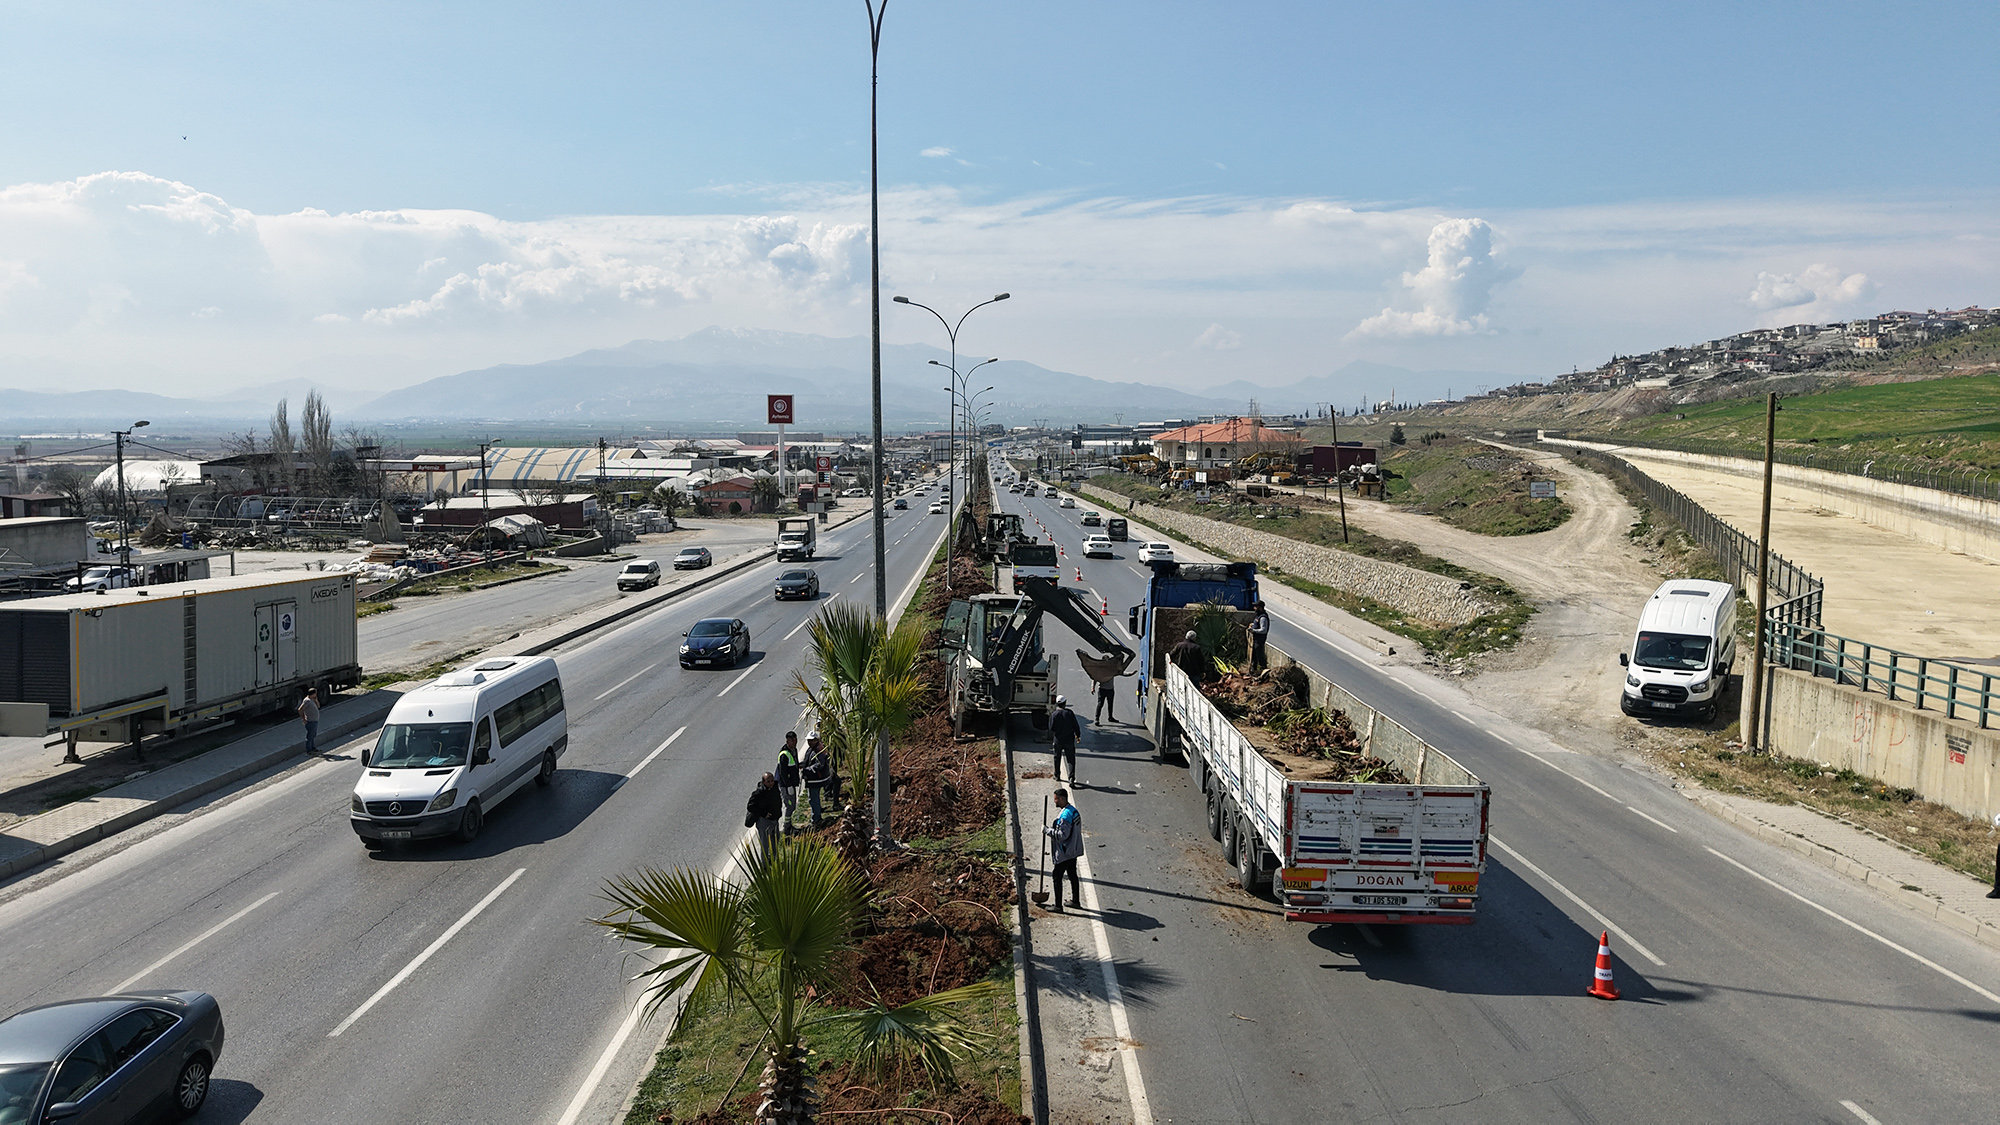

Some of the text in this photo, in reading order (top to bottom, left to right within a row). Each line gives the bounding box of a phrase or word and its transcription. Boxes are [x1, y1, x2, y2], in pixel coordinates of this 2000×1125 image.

[1286, 880, 1309, 889] UZUN
[1450, 884, 1474, 893] ARAÇ
[1362, 896, 1370, 905] 31
[1386, 896, 1400, 905] 528
